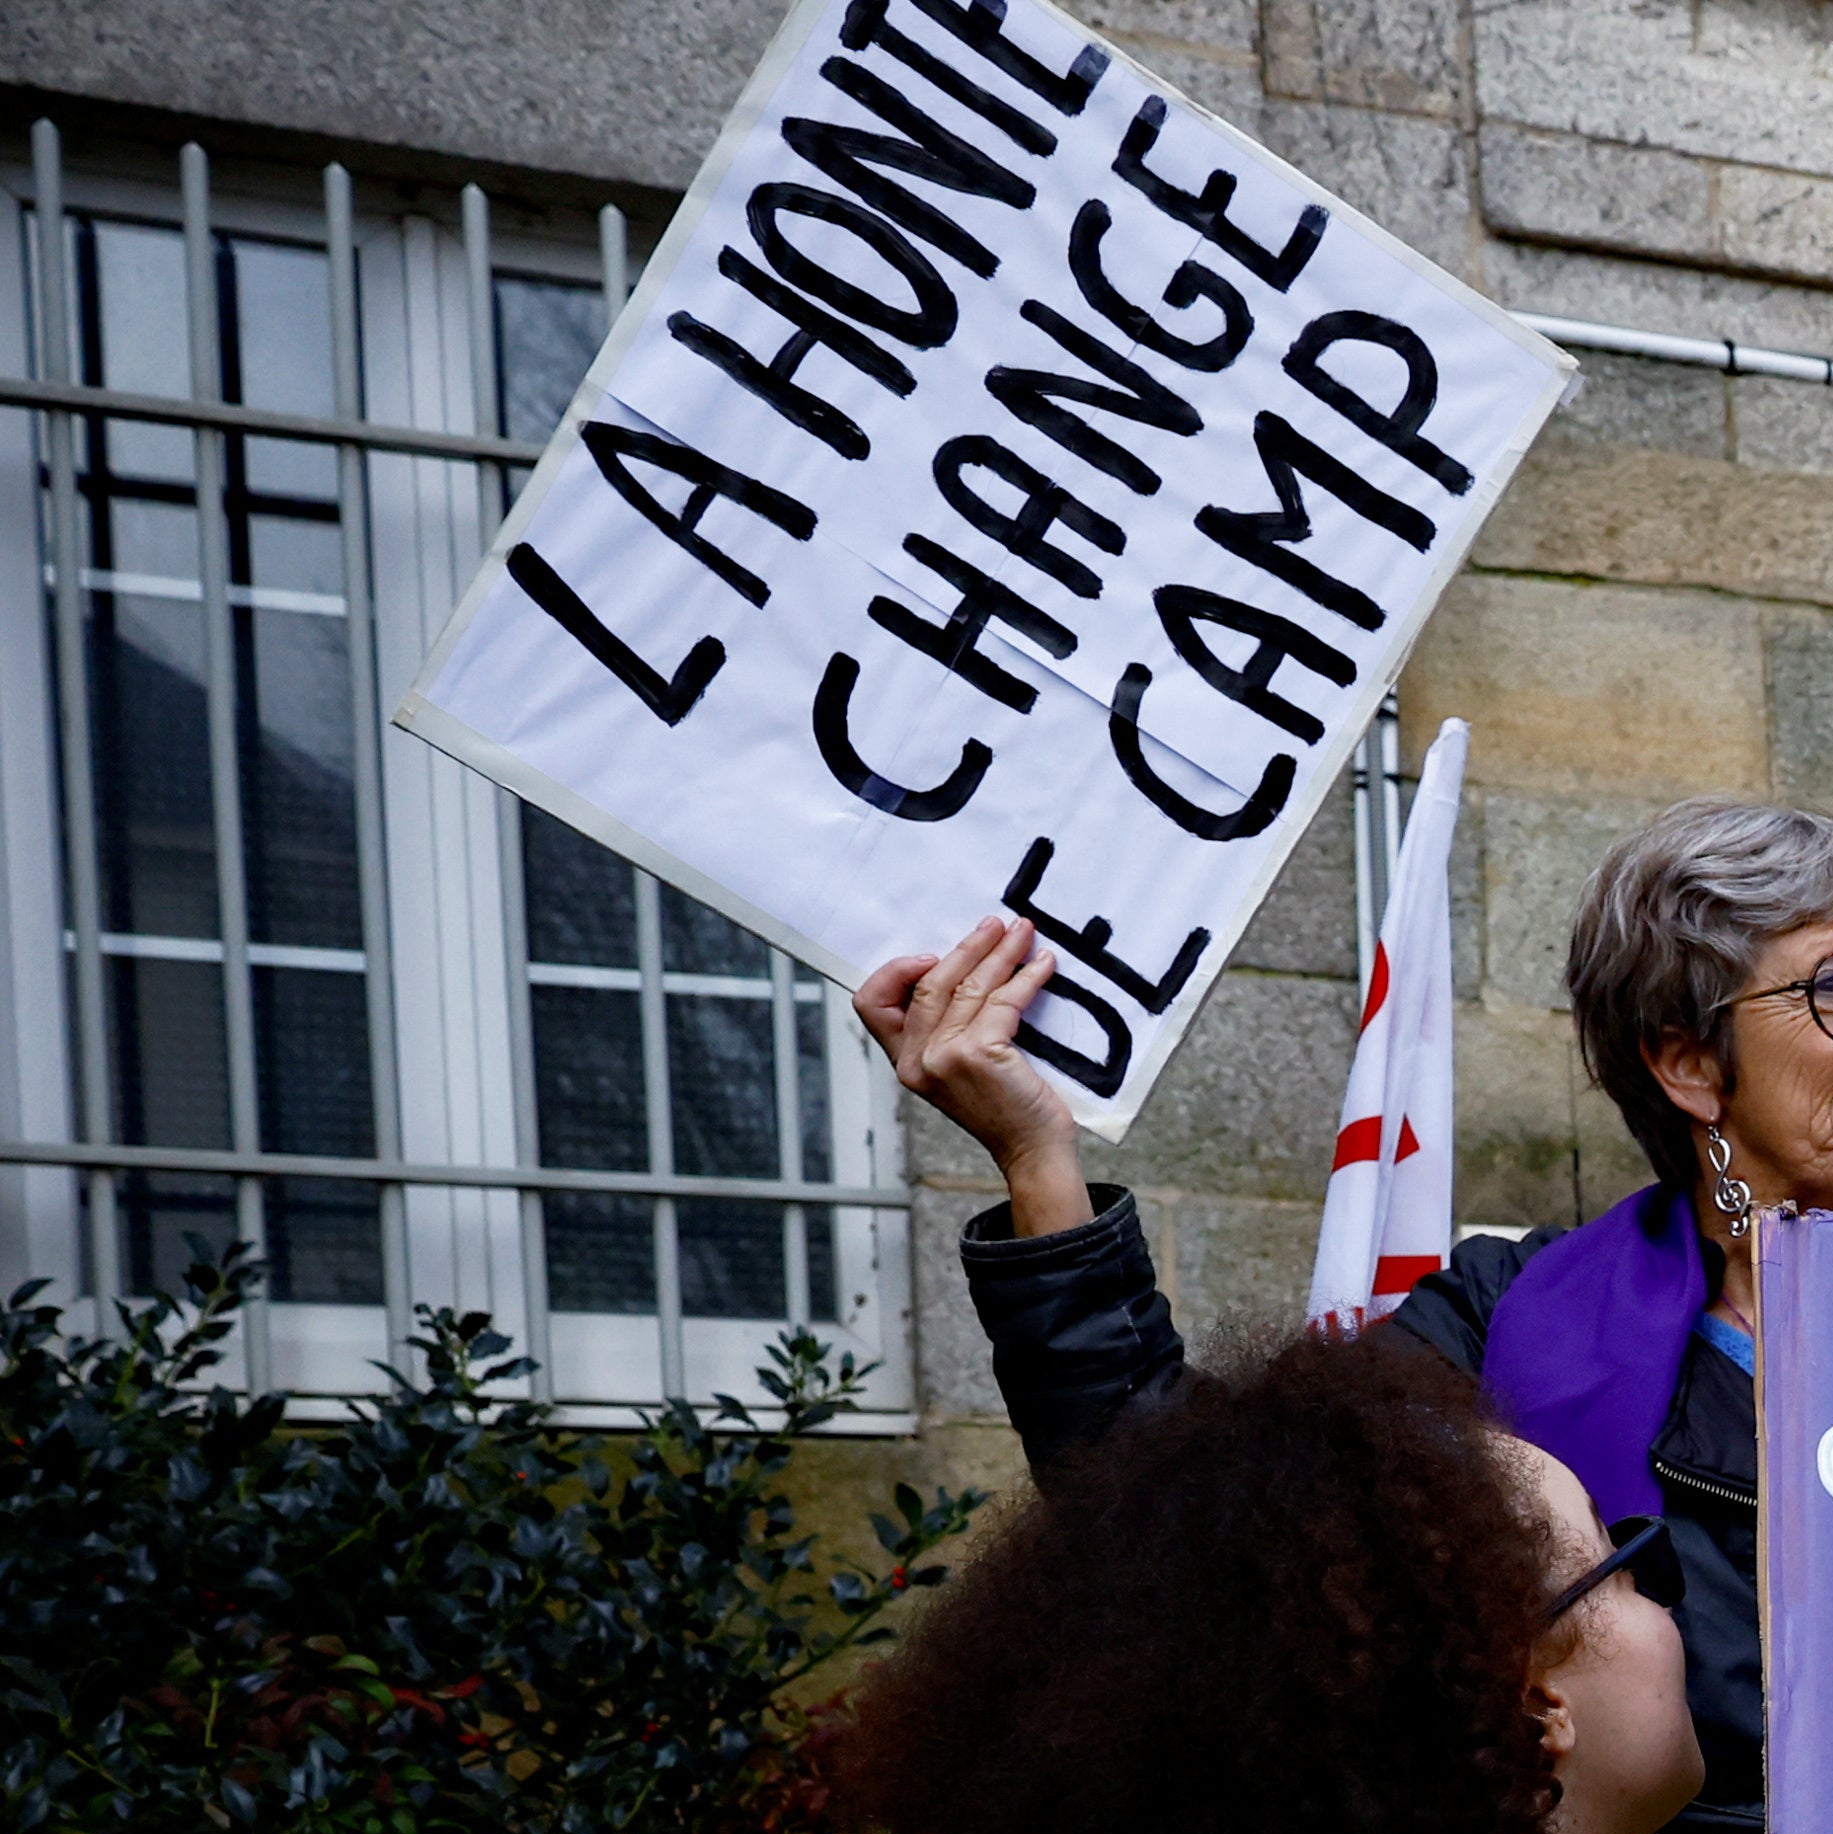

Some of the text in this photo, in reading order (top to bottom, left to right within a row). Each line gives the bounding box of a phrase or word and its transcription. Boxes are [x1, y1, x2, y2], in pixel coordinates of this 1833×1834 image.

[507, 0, 1111, 727] LA HONTE
[813, 93, 1327, 821] CHANGE
[1001, 308, 1475, 1098] DE CAMP
